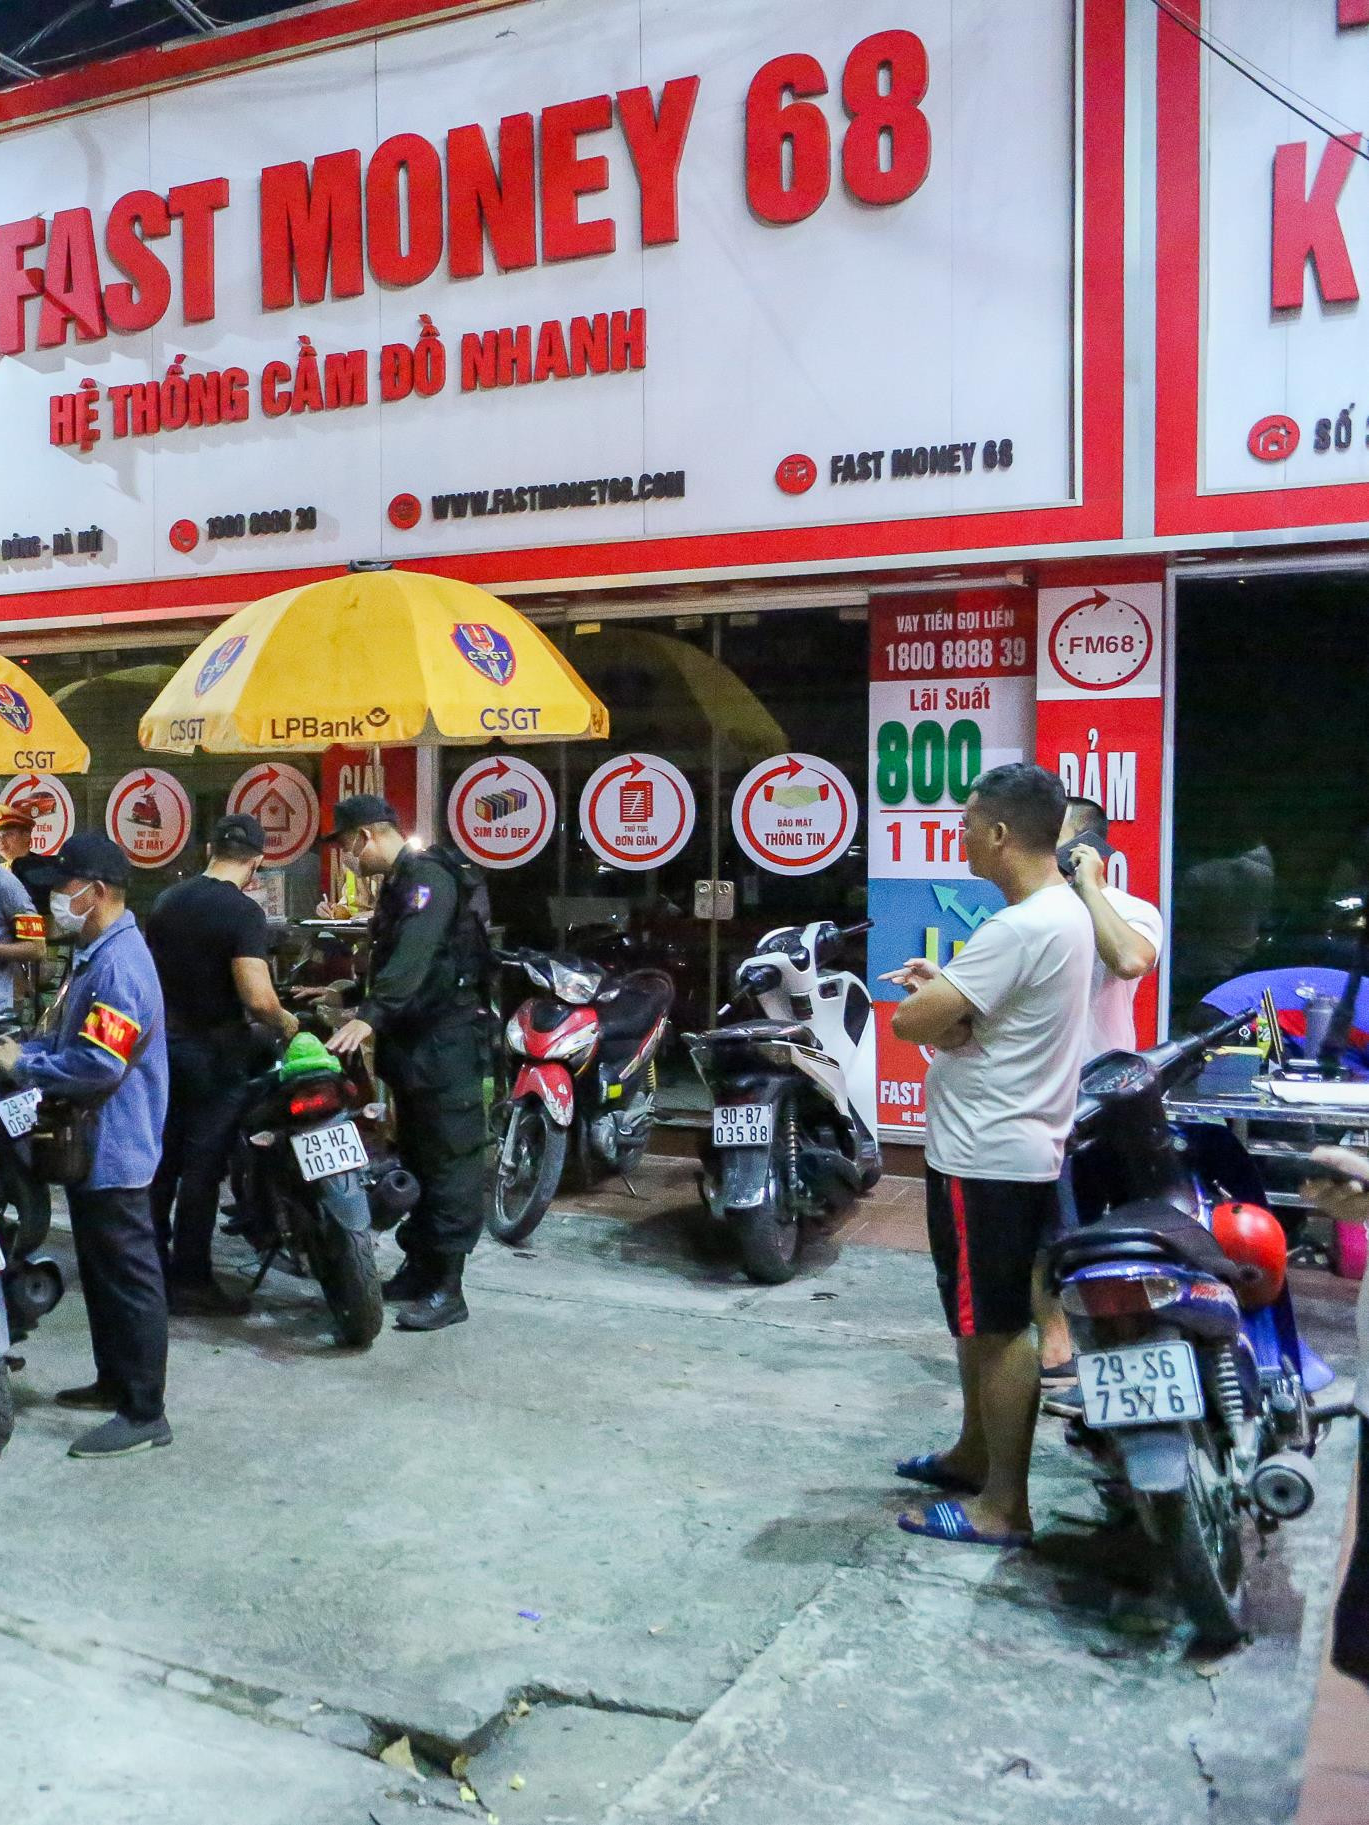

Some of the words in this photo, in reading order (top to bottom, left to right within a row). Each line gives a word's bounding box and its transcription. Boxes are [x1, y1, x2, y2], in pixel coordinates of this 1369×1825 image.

[260, 75, 700, 312] MONEY
[745, 28, 930, 224] 68
[50, 378, 101, 450] HỆ
[108, 354, 249, 437] THỐNG
[261, 335, 368, 418] CẦM
[380, 313, 445, 402] ĐỒ
[461, 307, 647, 391] NHANH
[1313, 402, 1356, 451] SỐ
[831, 451, 884, 484] FAST
[891, 442, 976, 479] MONEY
[896, 615, 921, 633] VAY
[957, 610, 981, 634] GỌI
[467, 651, 508, 660] CSGT
[886, 641, 935, 671] 1800
[942, 638, 993, 669] 8888
[1000, 636, 1027, 667] 39
[1069, 635, 1134, 654] FM68
[909, 688, 939, 711] Lãi
[945, 682, 991, 711] Suất
[170, 717, 206, 741] CSGT
[271, 717, 364, 740] LPBank
[480, 708, 541, 731] CSGT
[14, 751, 56, 770] CSGT
[877, 719, 982, 805] 800
[473, 826, 492, 838] SIM
[764, 830, 803, 846] THÔNG
[806, 832, 826, 846] TIN
[887, 822, 902, 862] 1
[880, 1081, 922, 1106] FAST
[721, 1107, 762, 1125] 90-B7
[301, 1128, 349, 1154] 29-H2
[305, 1145, 361, 1175] 103.02
[1092, 1350, 1176, 1386] 29-S6
[1096, 1384, 1185, 1420] 7576
